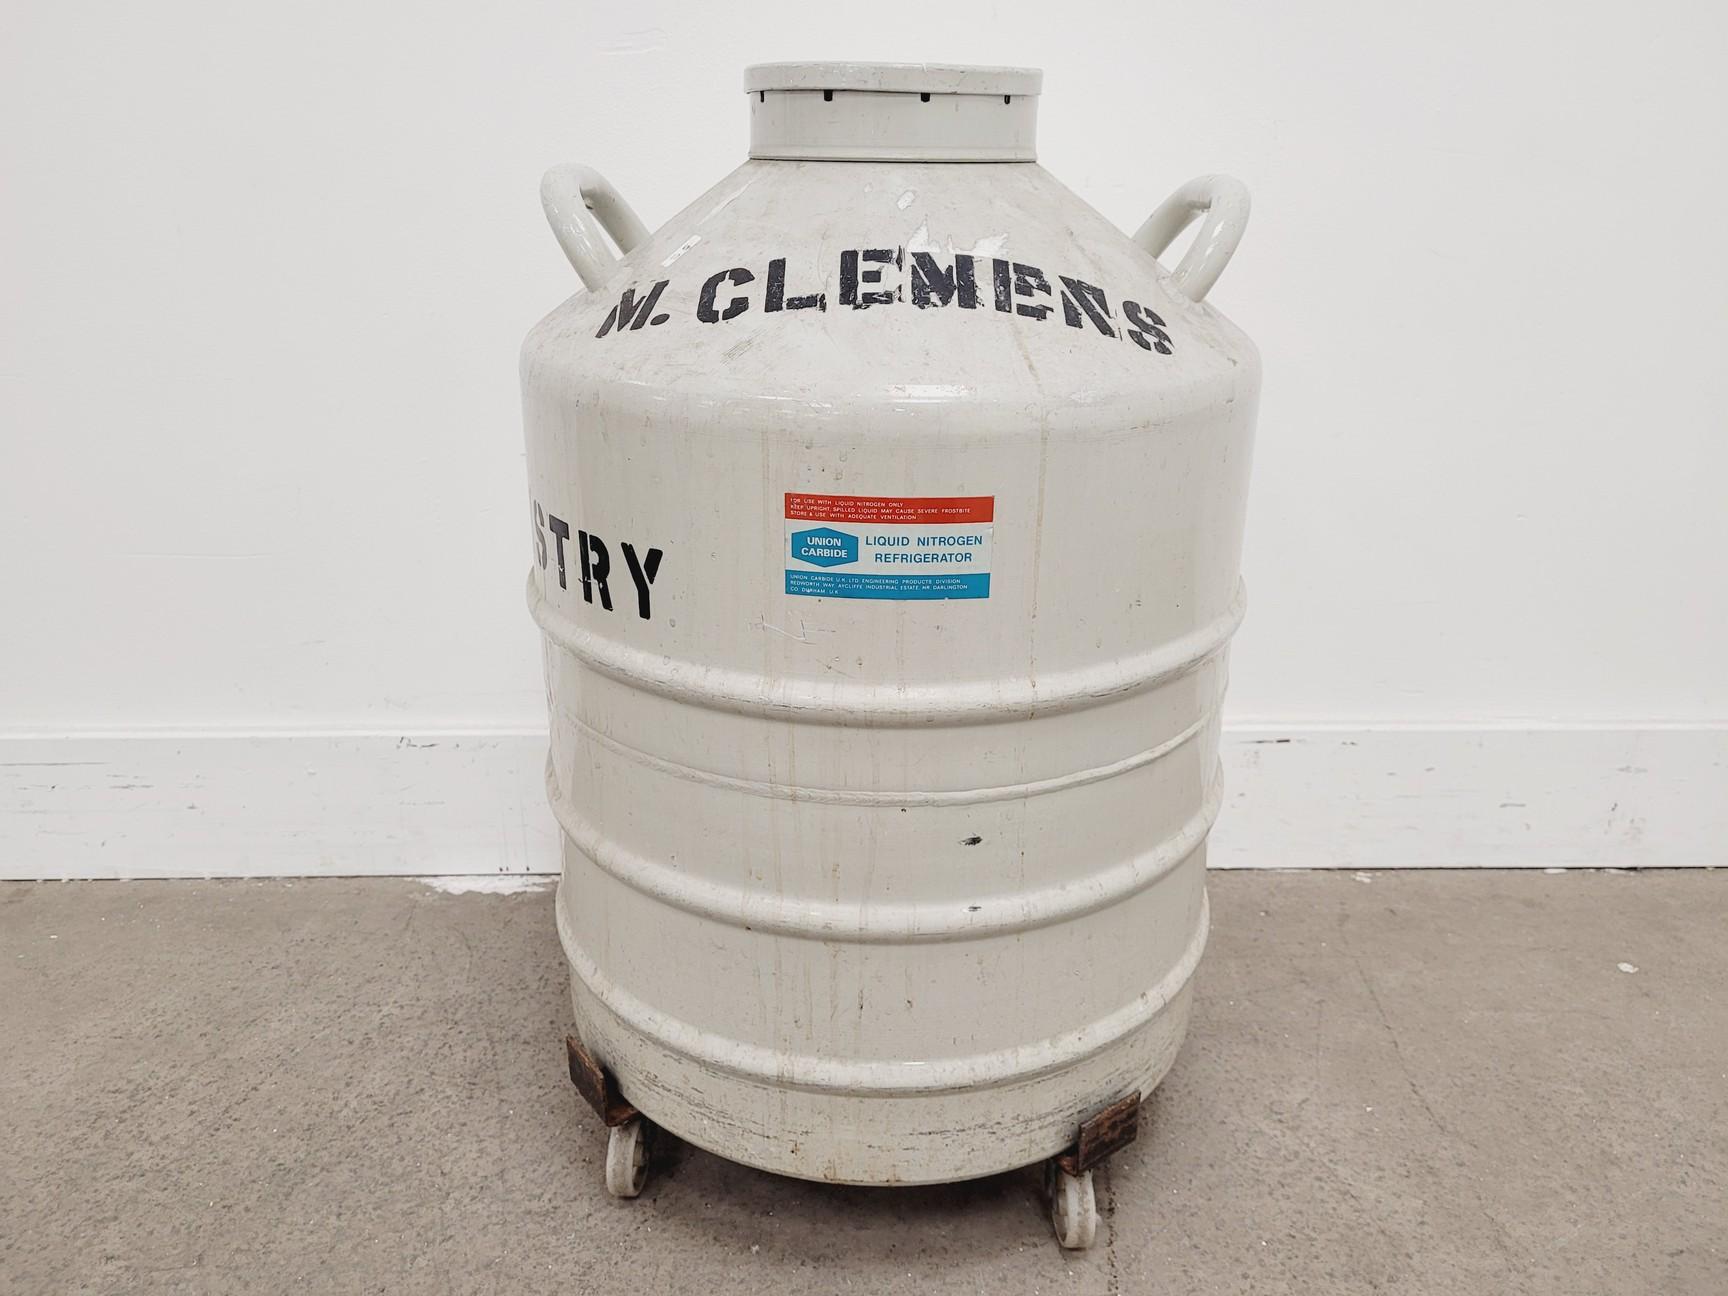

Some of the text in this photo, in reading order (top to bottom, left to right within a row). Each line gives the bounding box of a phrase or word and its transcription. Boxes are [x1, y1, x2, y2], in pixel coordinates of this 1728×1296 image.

[595, 245, 1175, 355] M. CLEMENS
[807, 536, 842, 546] UNION
[865, 536, 983, 547] LIQUID NITROGEN
[801, 547, 848, 558] CARBIDE
[874, 552, 972, 564] REFRIGERATOR
